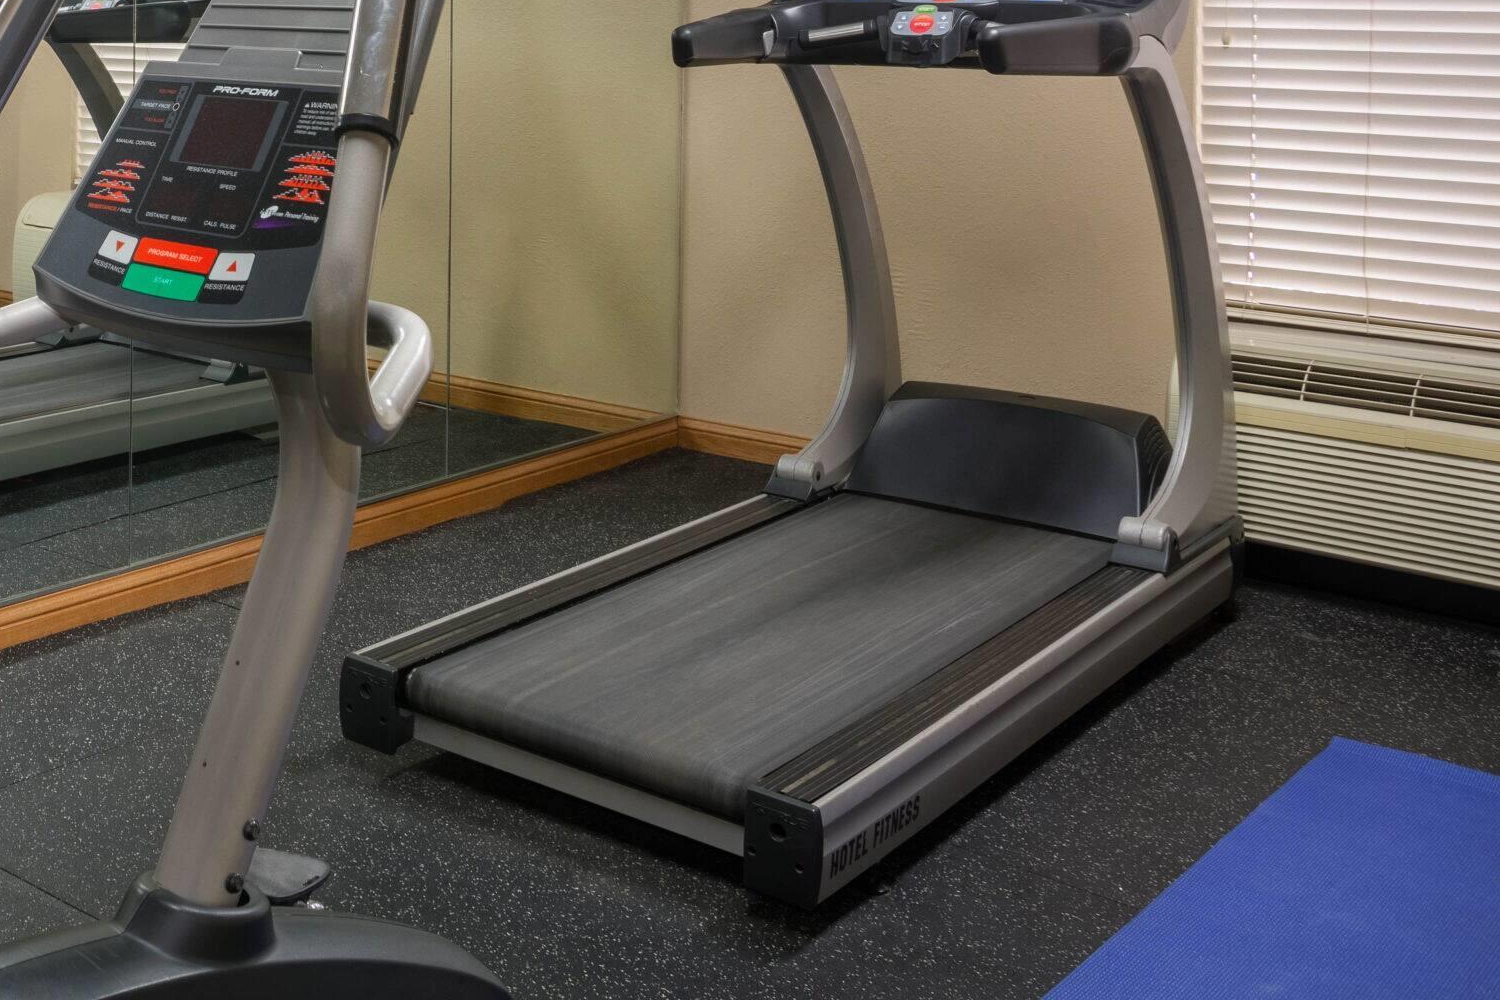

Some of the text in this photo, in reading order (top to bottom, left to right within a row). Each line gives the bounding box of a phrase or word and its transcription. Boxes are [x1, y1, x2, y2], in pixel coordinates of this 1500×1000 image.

[213, 85, 279, 97] PRO-FORM
[186, 165, 239, 177] RESISTANCE PROFILE
[219, 183, 236, 191] SPEED
[145, 211, 169, 220] DISTANCE
[148, 247, 204, 263] PROGRAM SELECT
[93, 258, 126, 275] RESISTANCE
[153, 276, 173, 286] START
[204, 283, 245, 292] RESISTANCE
[830, 795, 920, 879] HOTEL FITNESS
